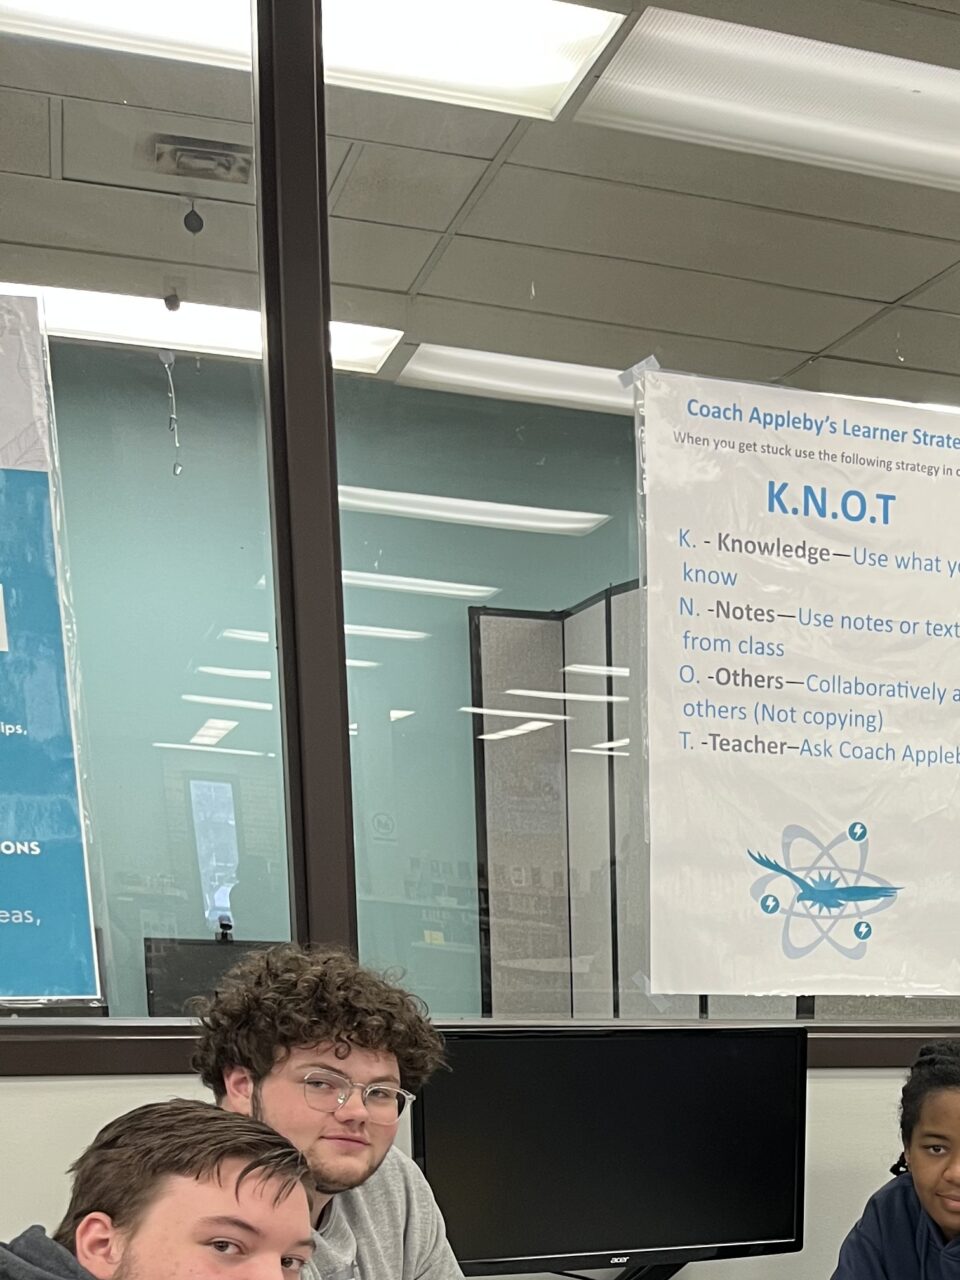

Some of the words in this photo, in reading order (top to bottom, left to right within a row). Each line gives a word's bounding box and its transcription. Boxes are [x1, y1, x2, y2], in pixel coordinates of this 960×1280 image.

[687, 399, 743, 422] Coach
[843, 419, 908, 443] Learner
[674, 431, 710, 447] When
[713, 438, 735, 450] you
[739, 442, 758, 453] get
[761, 444, 792, 457] stuck
[795, 449, 815, 459] use
[819, 449, 837, 463] the
[841, 451, 893, 471] following
[895, 460, 940, 476] strategy
[943, 464, 952, 476] in
[768, 480, 896, 525] K.N.O.T
[679, 528, 696, 548] K.
[895, 552, 941, 573] what
[683, 561, 737, 587] know
[679, 597, 700, 617] N.
[841, 614, 894, 633] notes
[900, 619, 919, 635] or
[926, 620, 960, 638] text
[683, 630, 731, 653] from
[738, 636, 784, 657] class
[679, 665, 700, 684] O.
[683, 699, 747, 720] others
[754, 702, 796, 725] (Not
[803, 709, 883, 732] copying)
[679, 731, 694, 750] T.
[840, 741, 896, 761] Coach
[0, 840, 41, 855] ONS
[610, 1256, 630, 1264] acer
